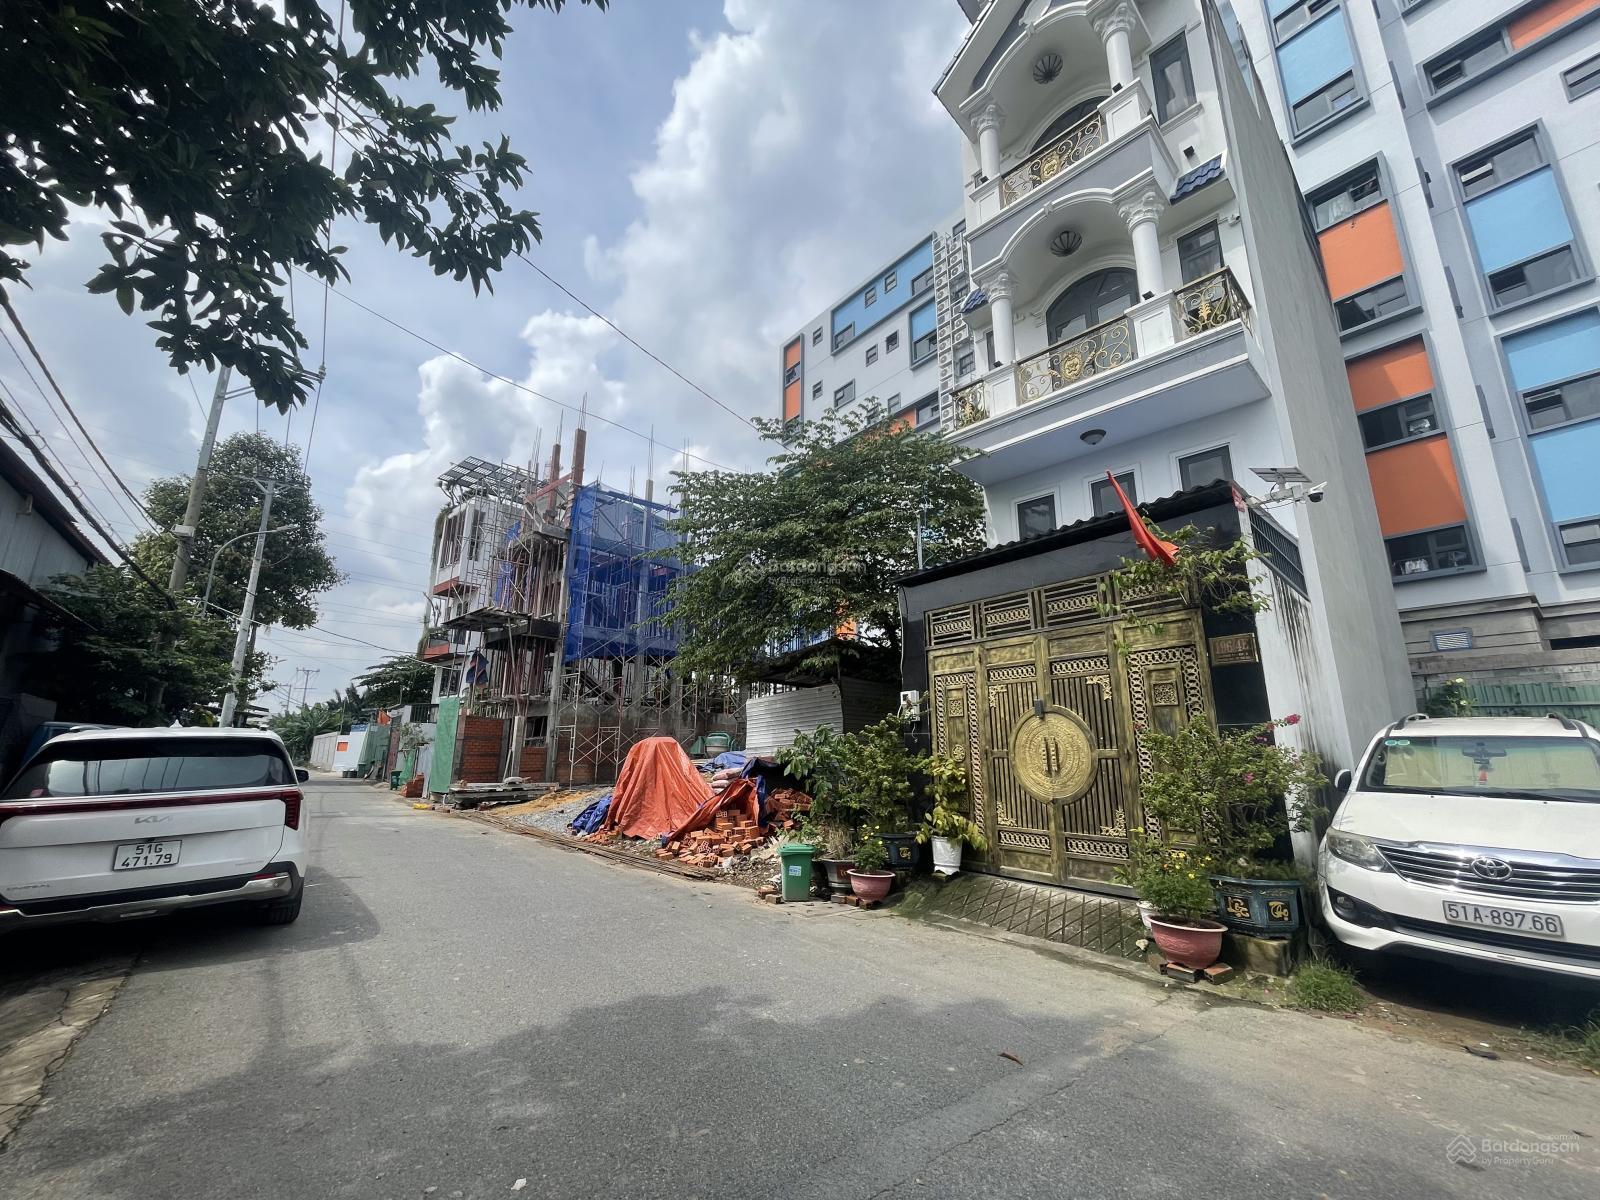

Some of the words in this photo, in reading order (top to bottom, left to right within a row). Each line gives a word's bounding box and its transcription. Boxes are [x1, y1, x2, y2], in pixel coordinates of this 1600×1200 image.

[135, 843, 164, 855] 51G
[121, 853, 173, 868] 471.79
[1447, 903, 1558, 933] 51A-897.66
